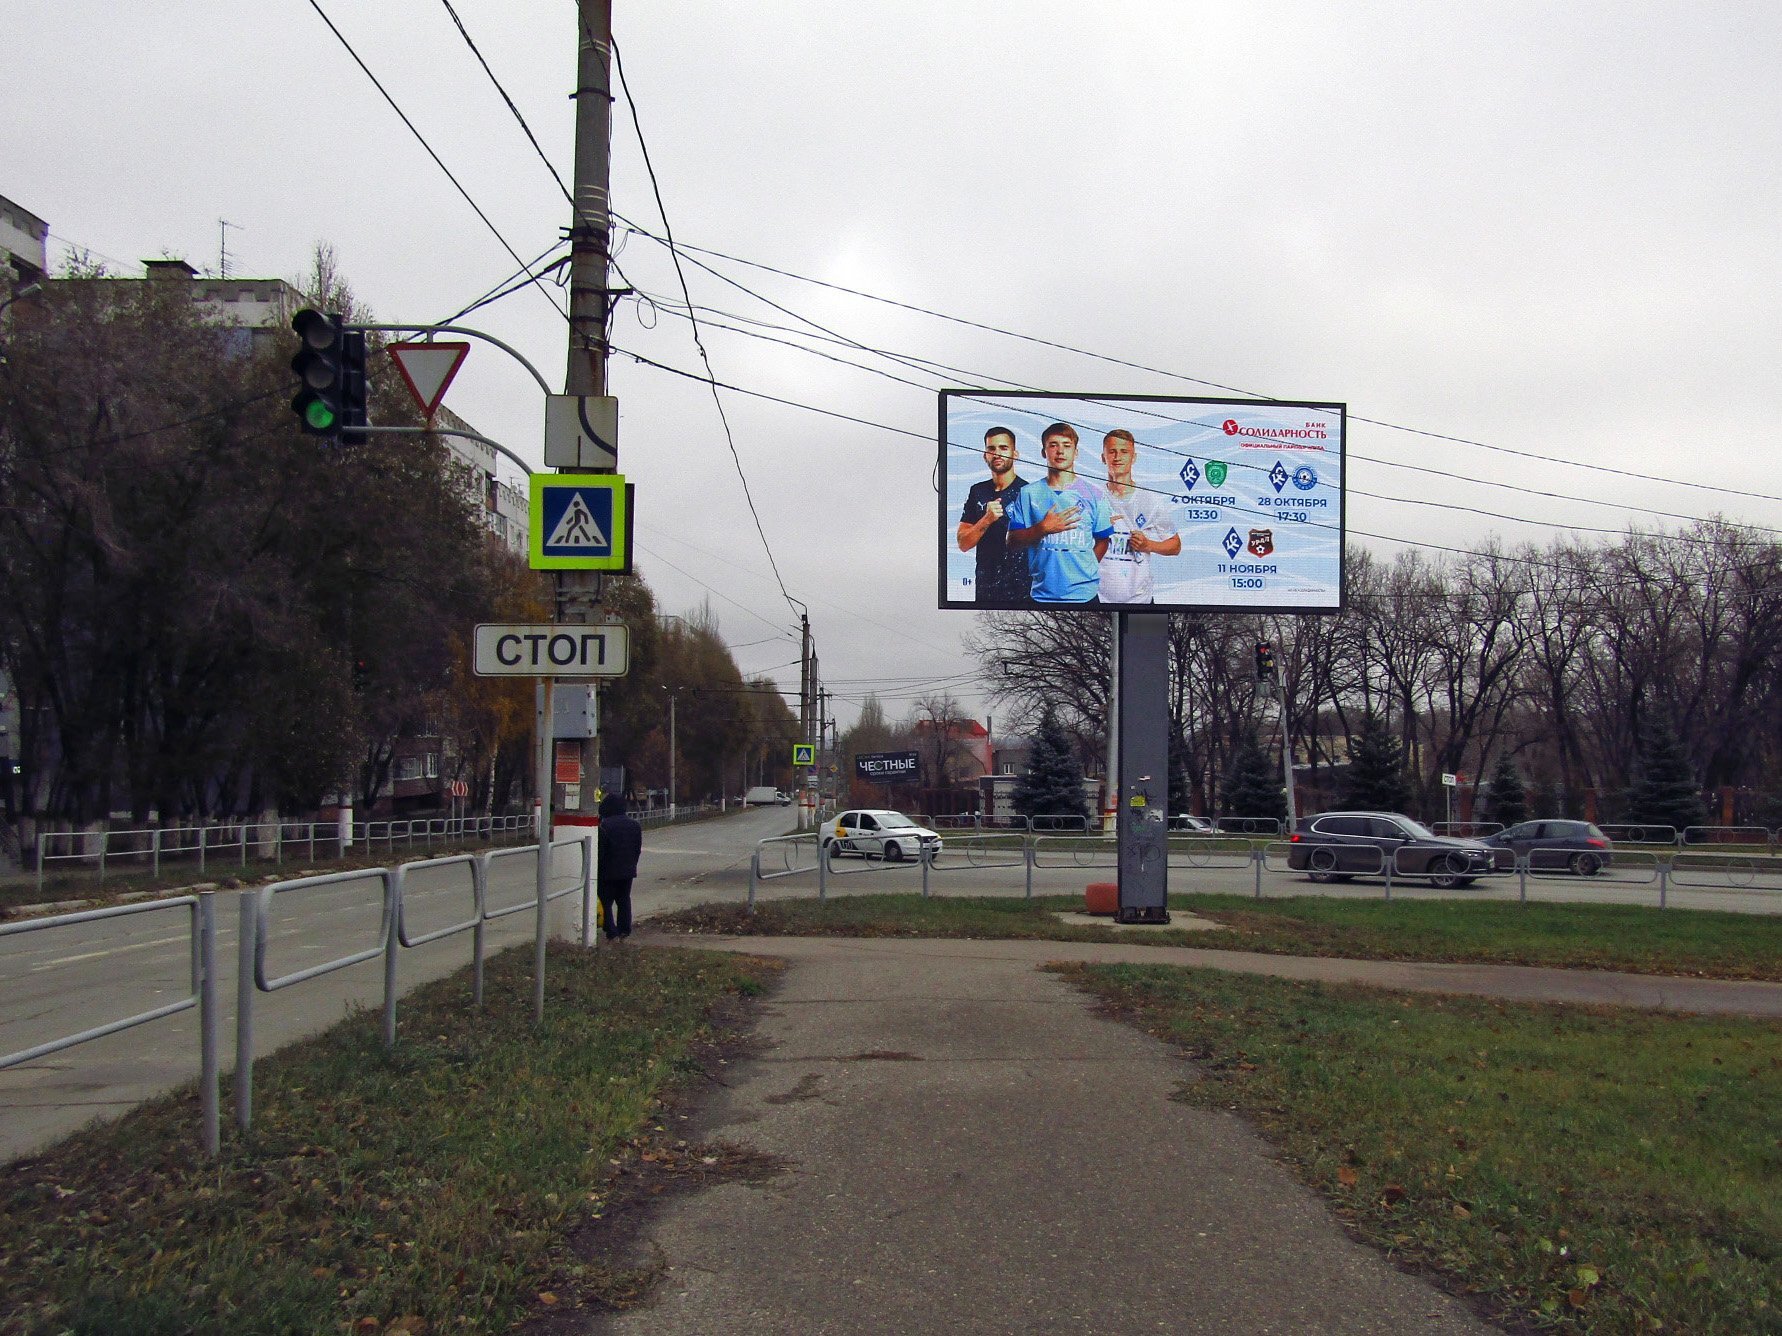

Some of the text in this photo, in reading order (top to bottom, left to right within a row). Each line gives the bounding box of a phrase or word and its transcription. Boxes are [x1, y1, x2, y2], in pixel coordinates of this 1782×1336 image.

[1239, 427, 1327, 439] СОЛИДАРНОСТЬ
[1182, 495, 1235, 505] ОКТЯБРЯ
[1258, 497, 1327, 507] 28 ОКТЯБРЯ
[1188, 509, 1218, 519] 13:30
[1277, 511, 1307, 522] 17:30
[1218, 564, 1277, 574] 11 НОЯБРЯ
[1232, 578, 1262, 588] 15:00
[496, 634, 606, 666] СТОП
[860, 758, 916, 771] ЧЕСТНЫЕ
